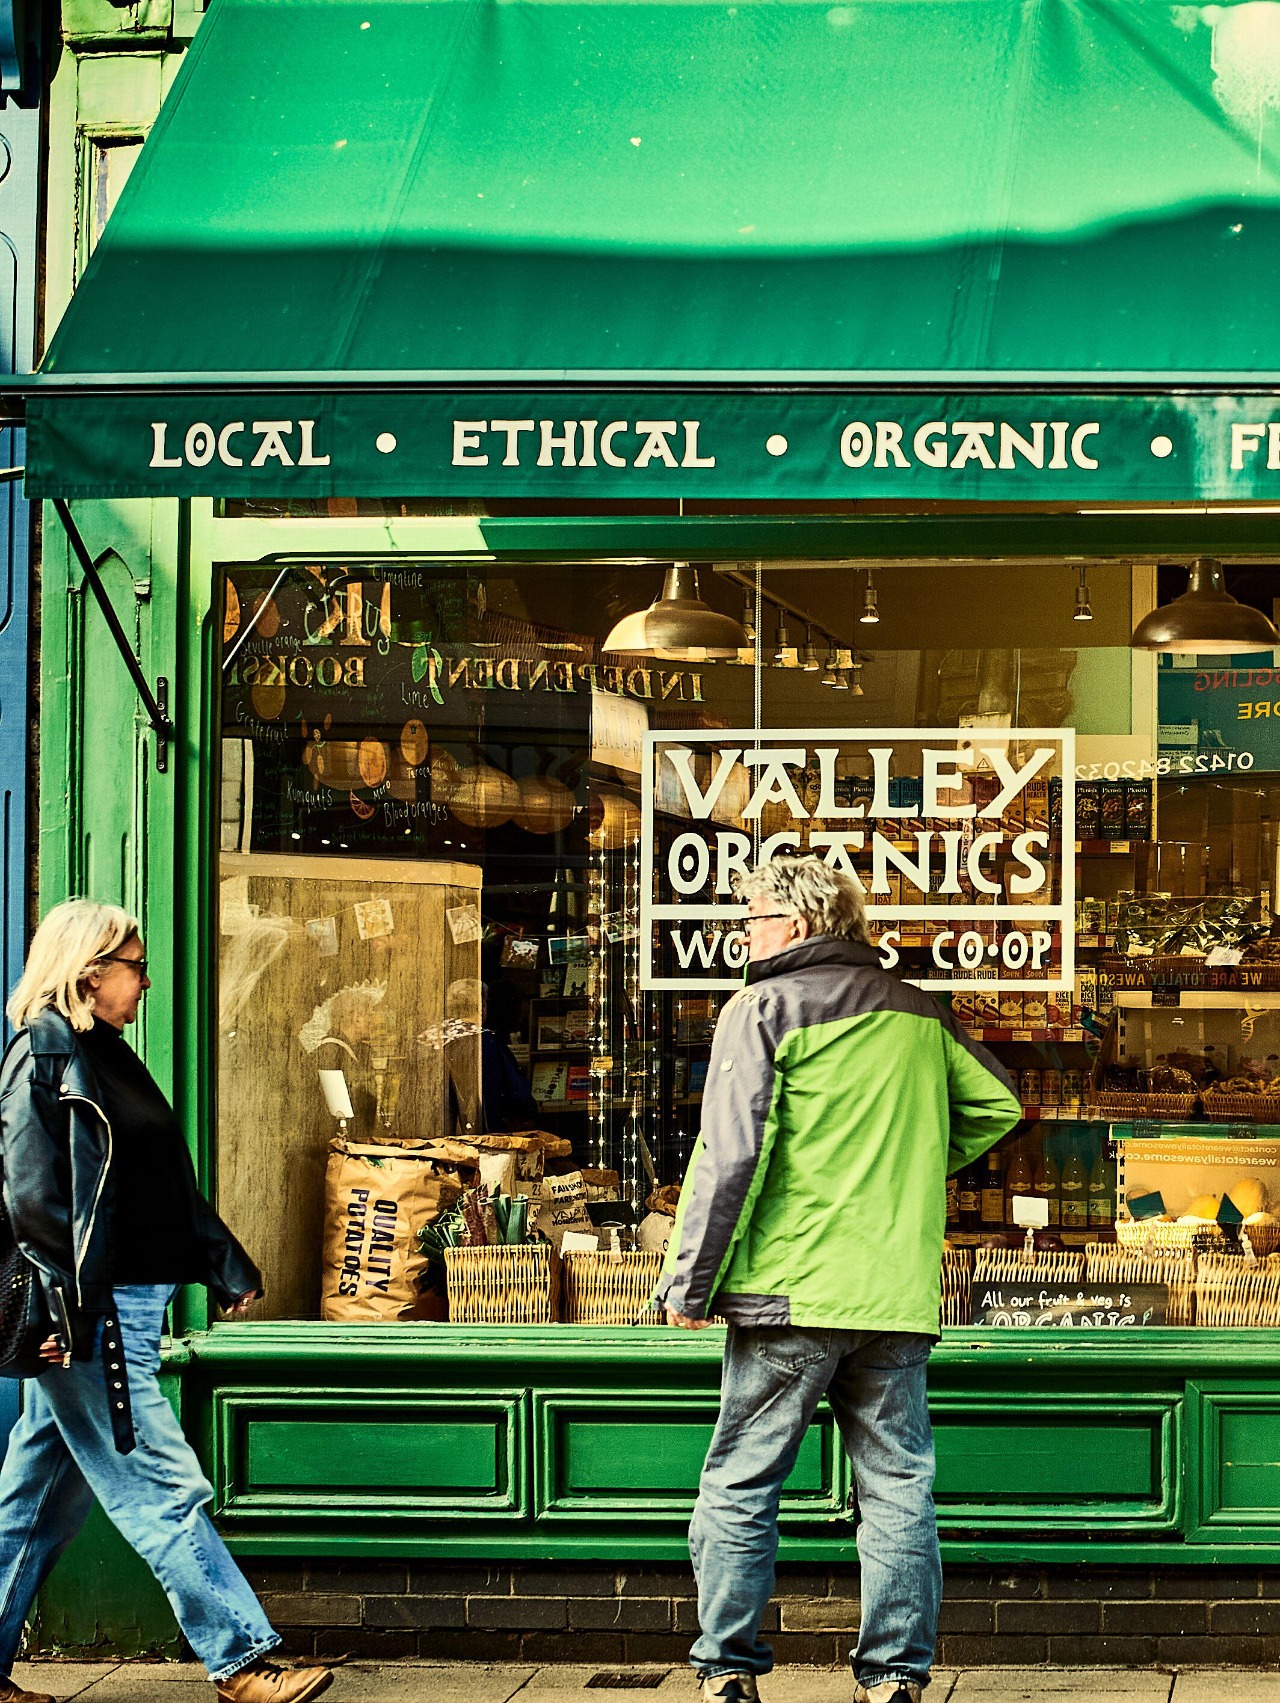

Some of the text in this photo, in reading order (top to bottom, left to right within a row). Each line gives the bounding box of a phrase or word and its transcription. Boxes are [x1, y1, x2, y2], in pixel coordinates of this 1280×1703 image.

[149, 420, 331, 468] LOCAL
[452, 419, 716, 468] ETHICAL
[840, 421, 1100, 471] ORGANIC
[373, 566, 423, 588] Clementine
[401, 682, 429, 709] Lime
[665, 748, 1057, 819] VALLEY
[1026, 781, 1047, 799] RUDE HEALTH
[383, 800, 450, 829] Blood oranges
[953, 970, 973, 980] RUDE
[977, 970, 997, 980] RUDE
[338, 1188, 369, 1297] POTATOES
[365, 1199, 398, 1293] QUALITY
[981, 1290, 1132, 1310] All our fruit & veg is
